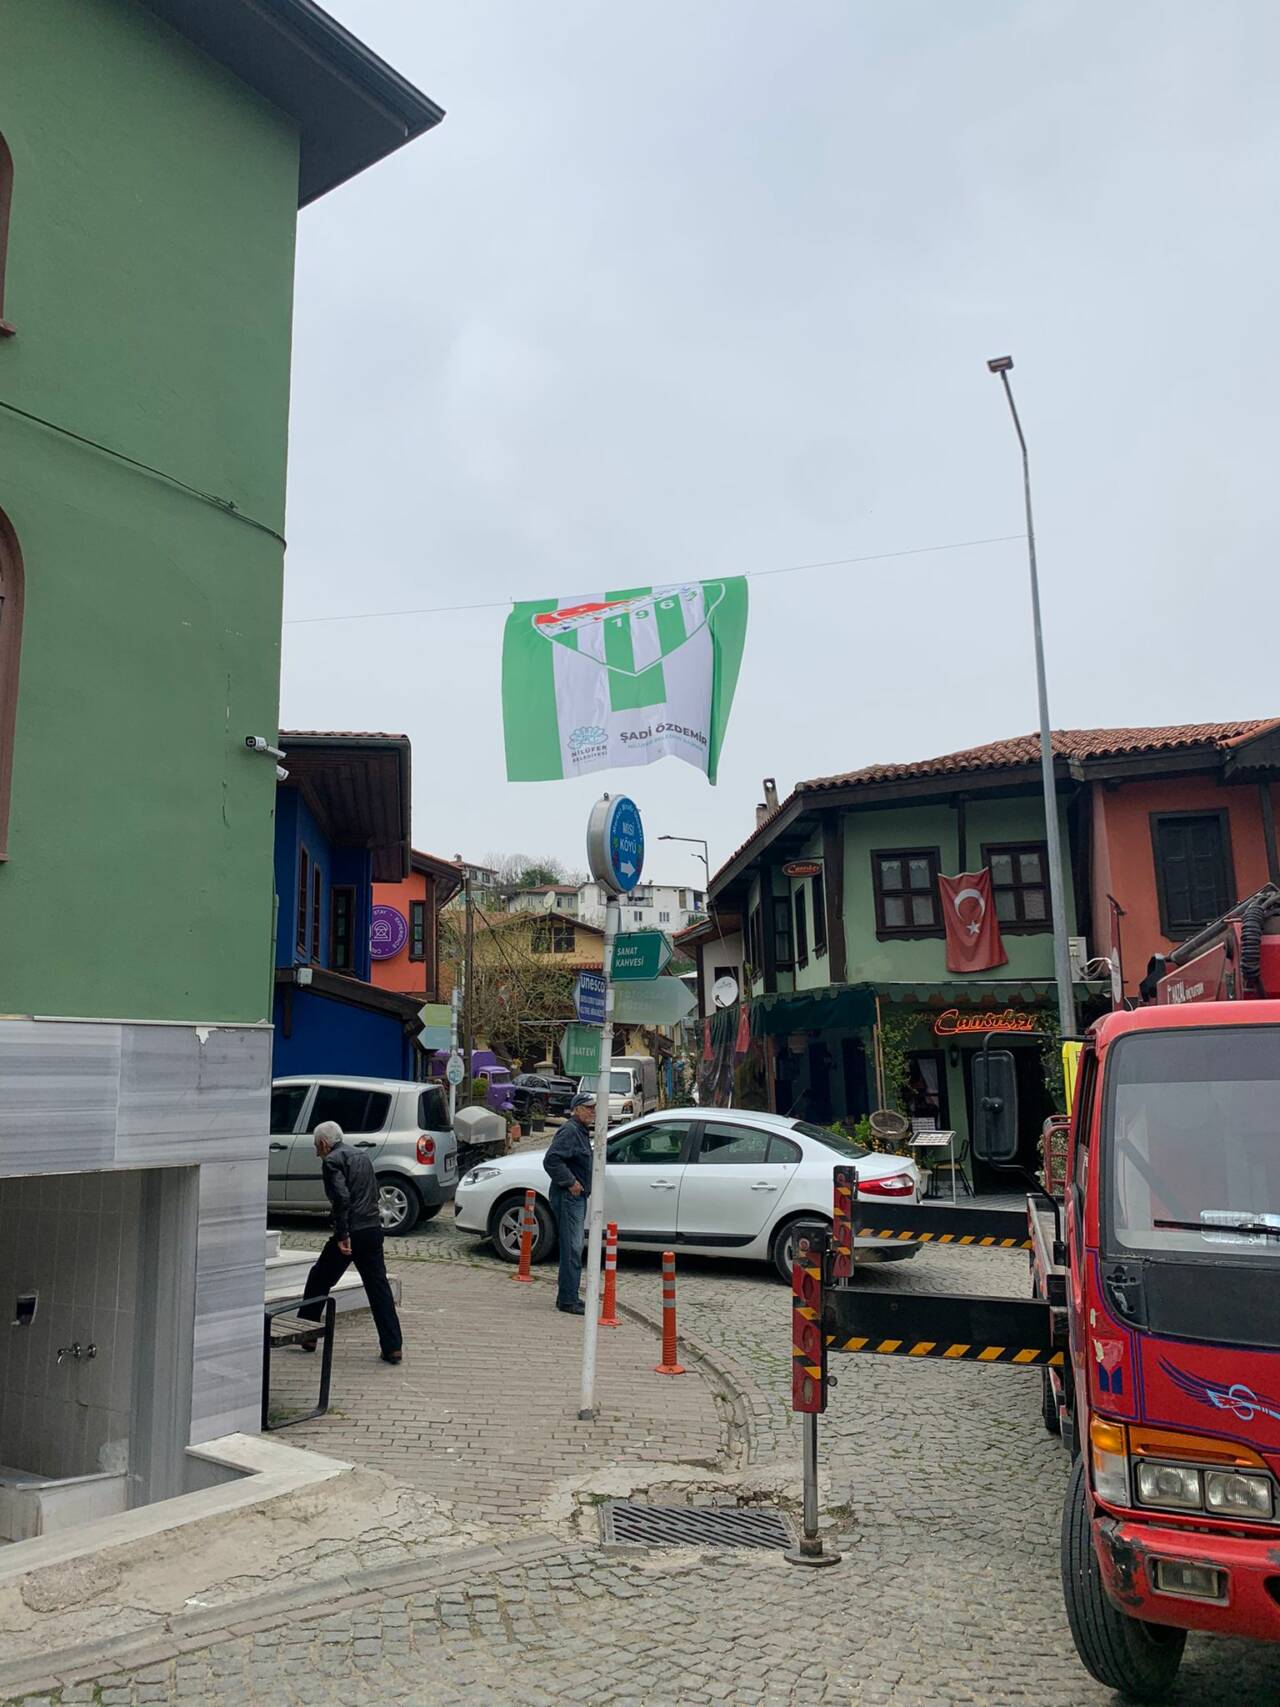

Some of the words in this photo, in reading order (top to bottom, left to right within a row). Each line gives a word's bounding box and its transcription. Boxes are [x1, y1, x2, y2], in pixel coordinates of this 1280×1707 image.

[620, 726, 653, 744] ŞADİ
[655, 722, 708, 747] ÖZDEMİR
[617, 946, 638, 956] SANAT
[615, 955, 645, 968] KAHVESİ
